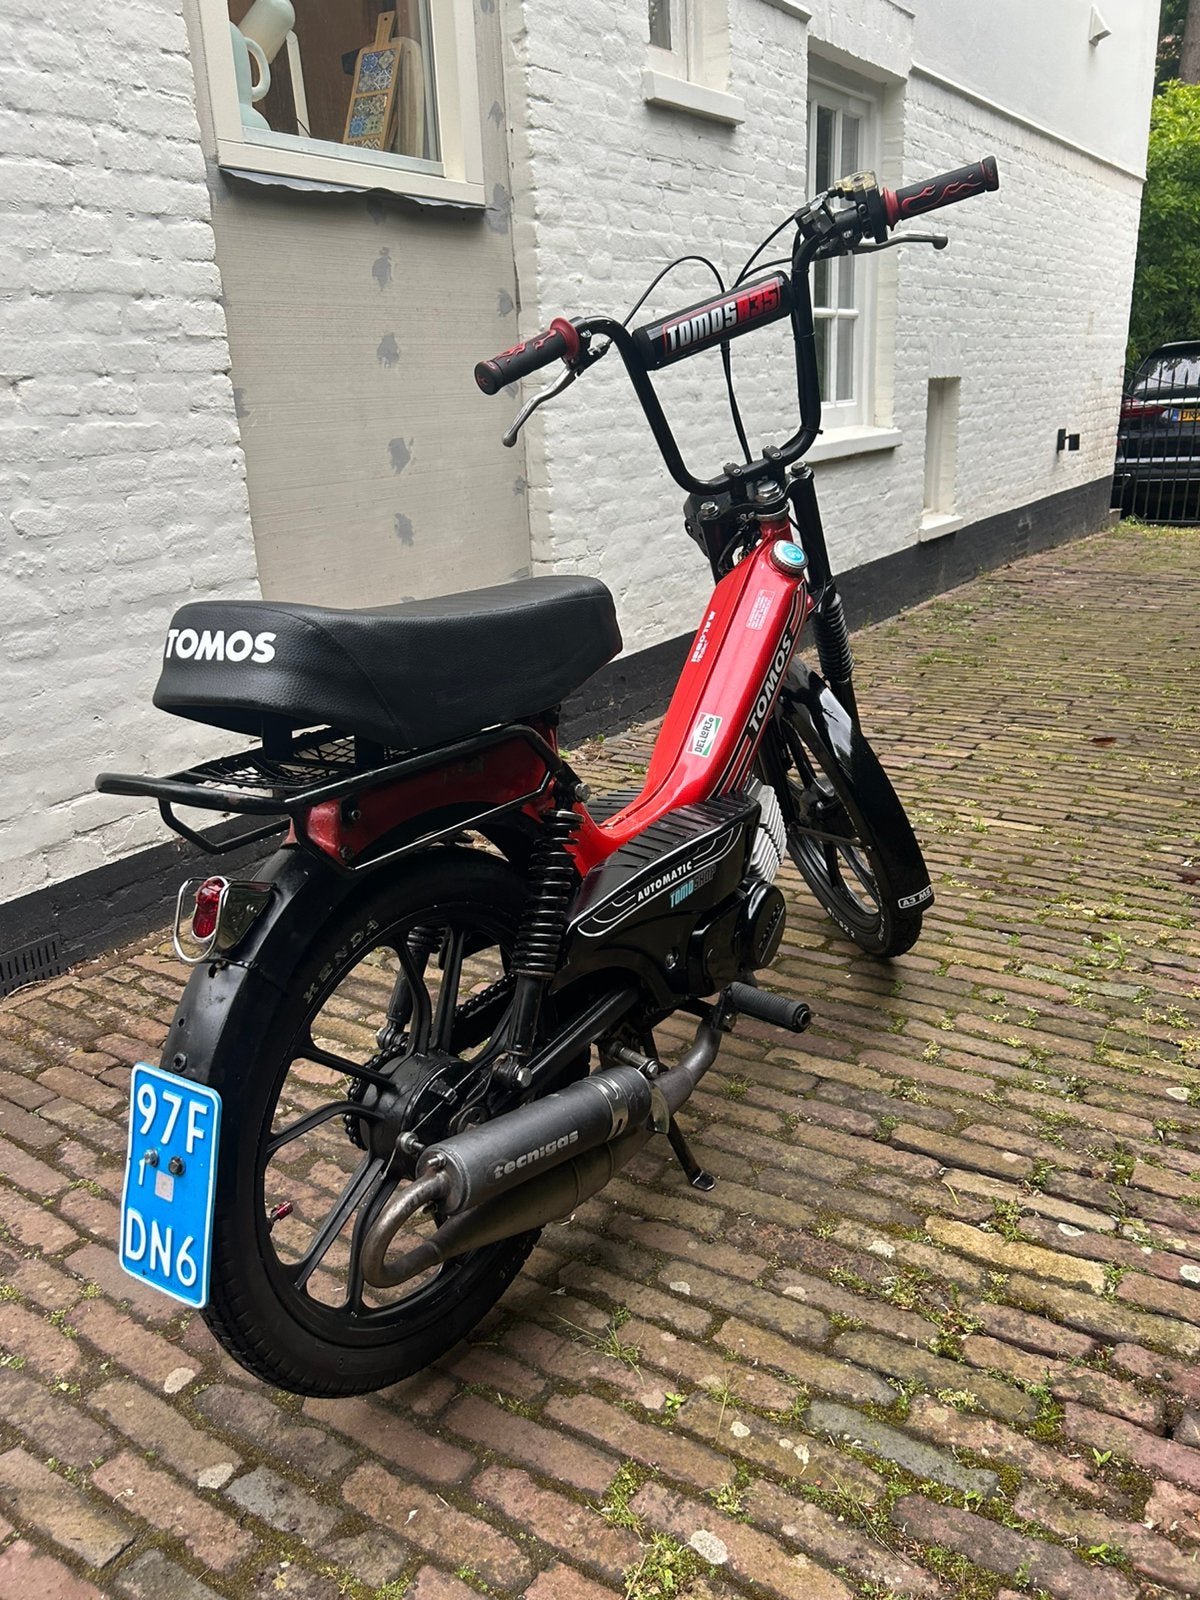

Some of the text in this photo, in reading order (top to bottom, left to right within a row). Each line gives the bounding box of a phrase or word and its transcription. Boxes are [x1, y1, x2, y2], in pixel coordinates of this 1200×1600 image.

[667, 302, 737, 351] TOMOS
[165, 628, 277, 664] TOMOS
[749, 634, 791, 732] TOMOS
[637, 861, 693, 902] AUTOMATIC
[303, 919, 379, 1004] KENDA
[137, 1083, 208, 1154] 97F
[493, 1130, 579, 1180] tecnigas
[125, 1206, 197, 1287] DN6
